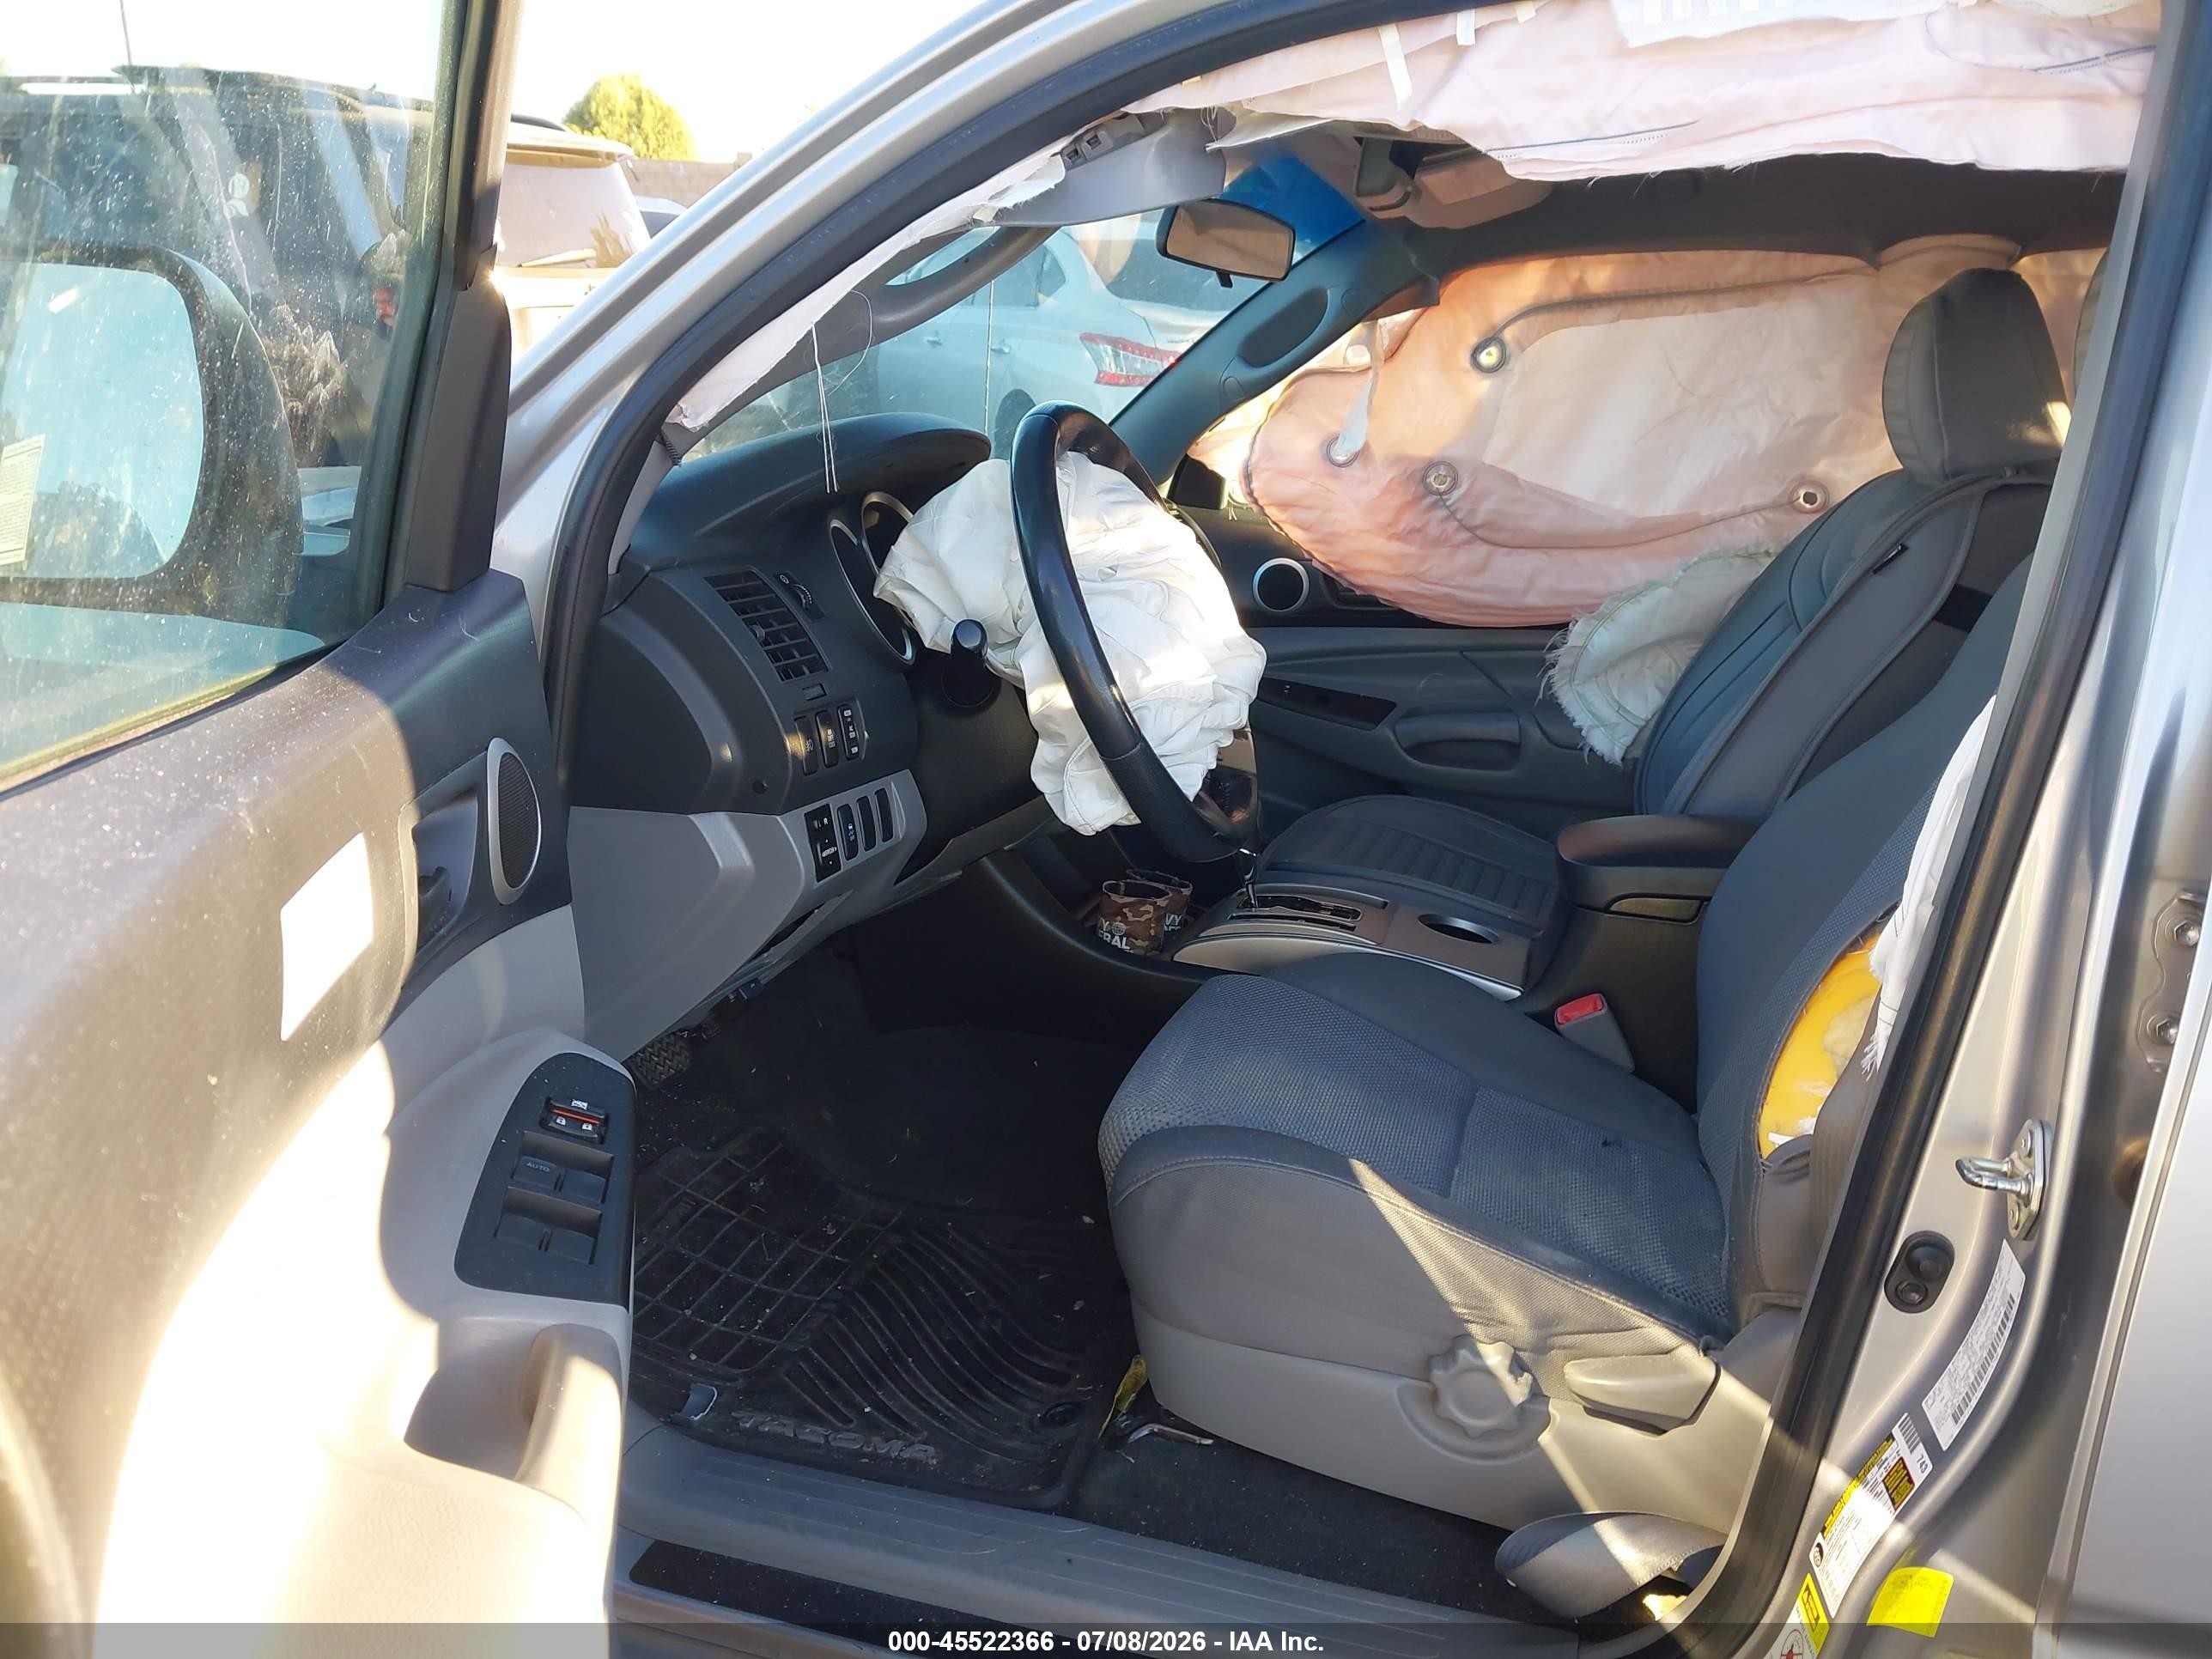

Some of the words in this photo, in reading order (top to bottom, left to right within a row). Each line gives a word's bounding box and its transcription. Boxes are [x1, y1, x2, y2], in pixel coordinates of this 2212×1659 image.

[526, 1161, 550, 1173] AUTO
[732, 1411, 938, 1465] TACOMA
[1916, 1453, 1929, 1474] 743
